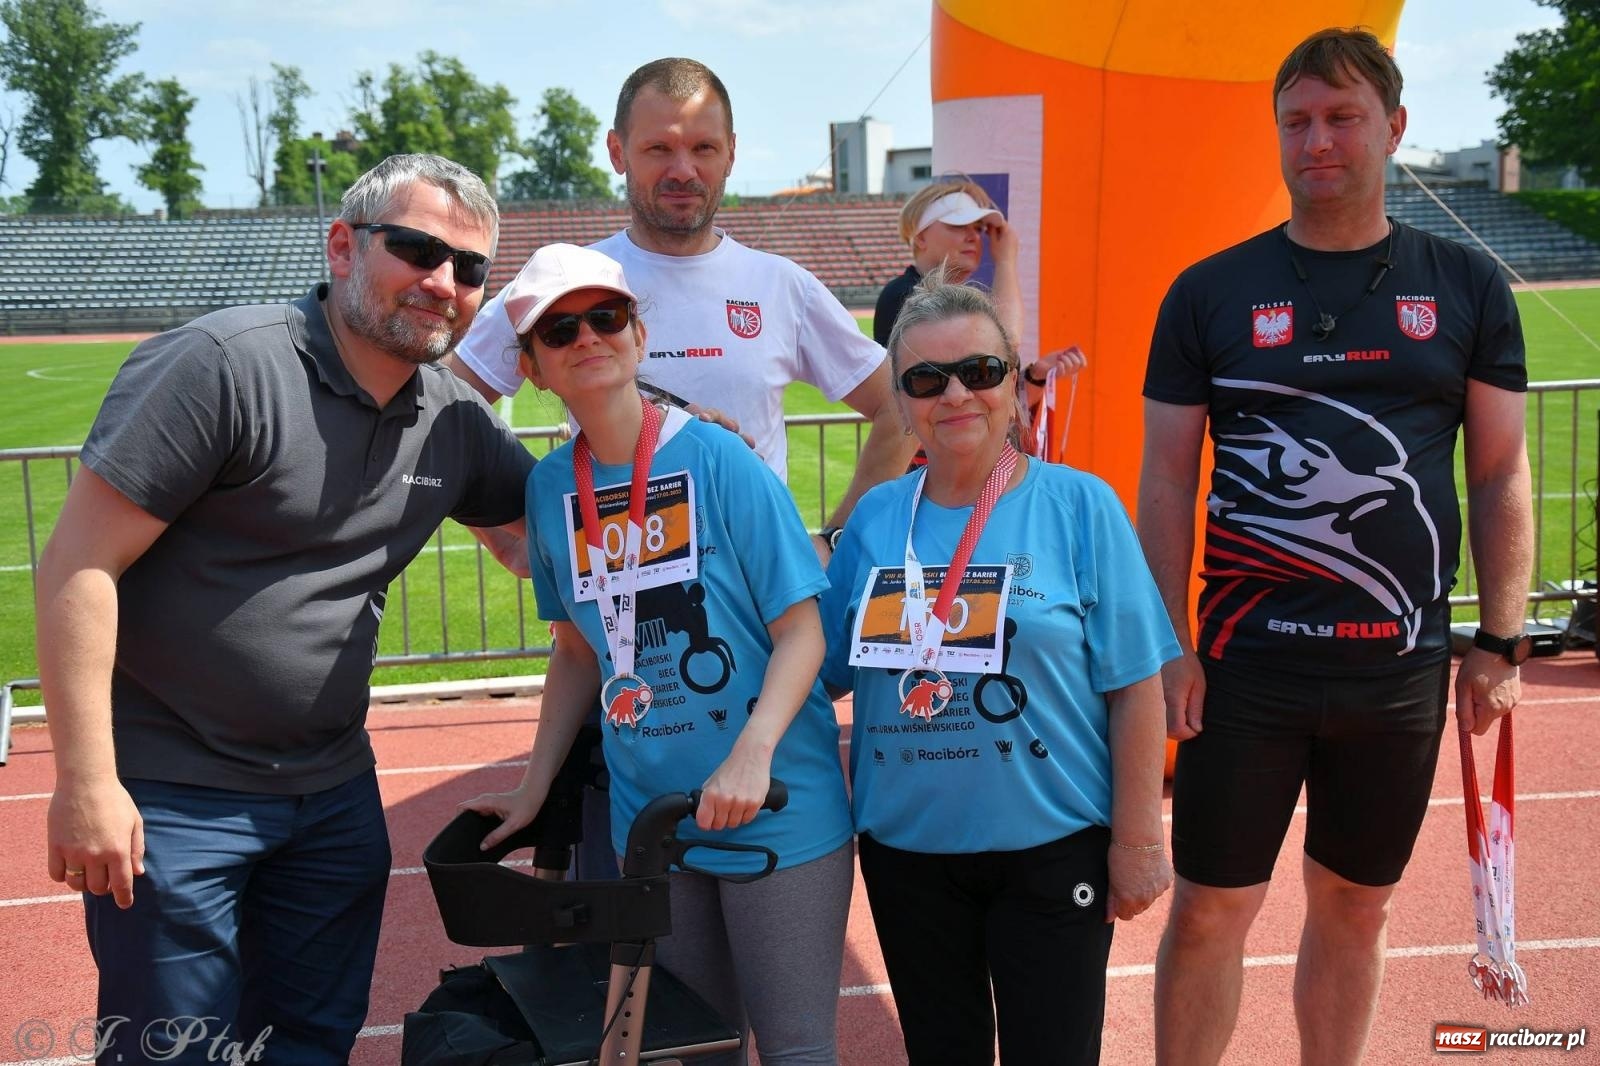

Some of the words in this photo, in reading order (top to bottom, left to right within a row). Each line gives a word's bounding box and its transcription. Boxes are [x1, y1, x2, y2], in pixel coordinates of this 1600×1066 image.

[1396, 294, 1436, 302] RACIBÓRZ
[1252, 300, 1293, 310] POLSKA
[596, 490, 629, 503] ACIBORSKI
[660, 480, 682, 491] BARIER
[602, 514, 665, 560] 08
[897, 571, 938, 579] RARSKI
[1008, 585, 1046, 601] ibórz
[900, 721, 976, 734] WIŚNIEWSKIEGO
[917, 747, 980, 761] Racibórz
